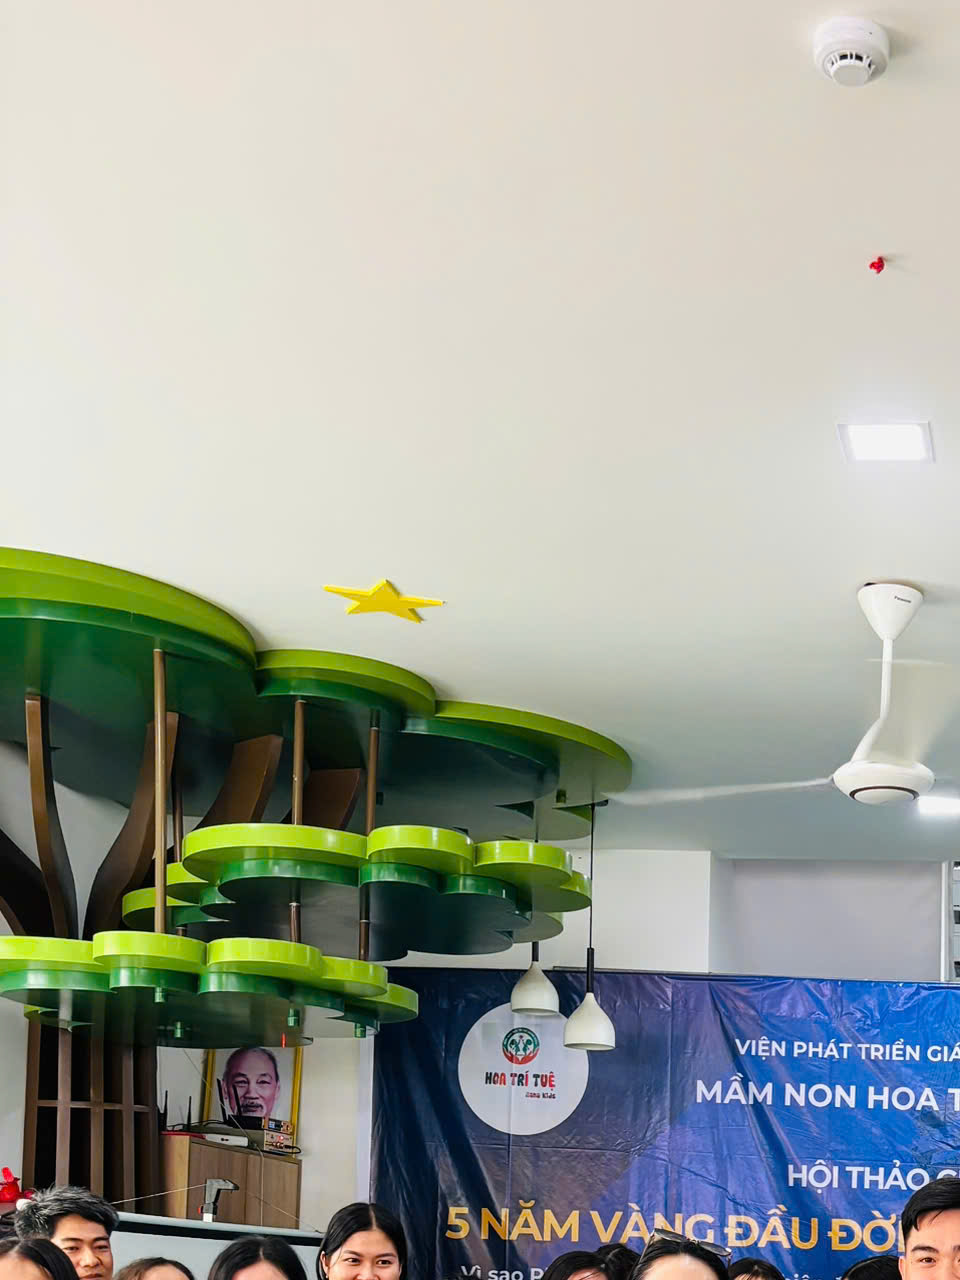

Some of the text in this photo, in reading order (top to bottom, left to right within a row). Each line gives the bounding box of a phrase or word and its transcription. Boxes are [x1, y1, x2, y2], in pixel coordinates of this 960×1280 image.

[735, 1036, 786, 1061] VIỆN
[793, 1039, 851, 1059] PHÁT
[858, 1038, 920, 1061] TRIỂN
[485, 1070, 556, 1091] HOA TRÍ TUỆ
[696, 1072, 773, 1105] MẦM
[784, 1083, 856, 1108] NON
[868, 1086, 939, 1112] HOA
[788, 1160, 839, 1194] HỘI
[846, 1160, 930, 1192] THẢO
[445, 1206, 470, 1240] 5
[480, 1200, 580, 1243] NĂM
[724, 1204, 819, 1251] ĐẦU
